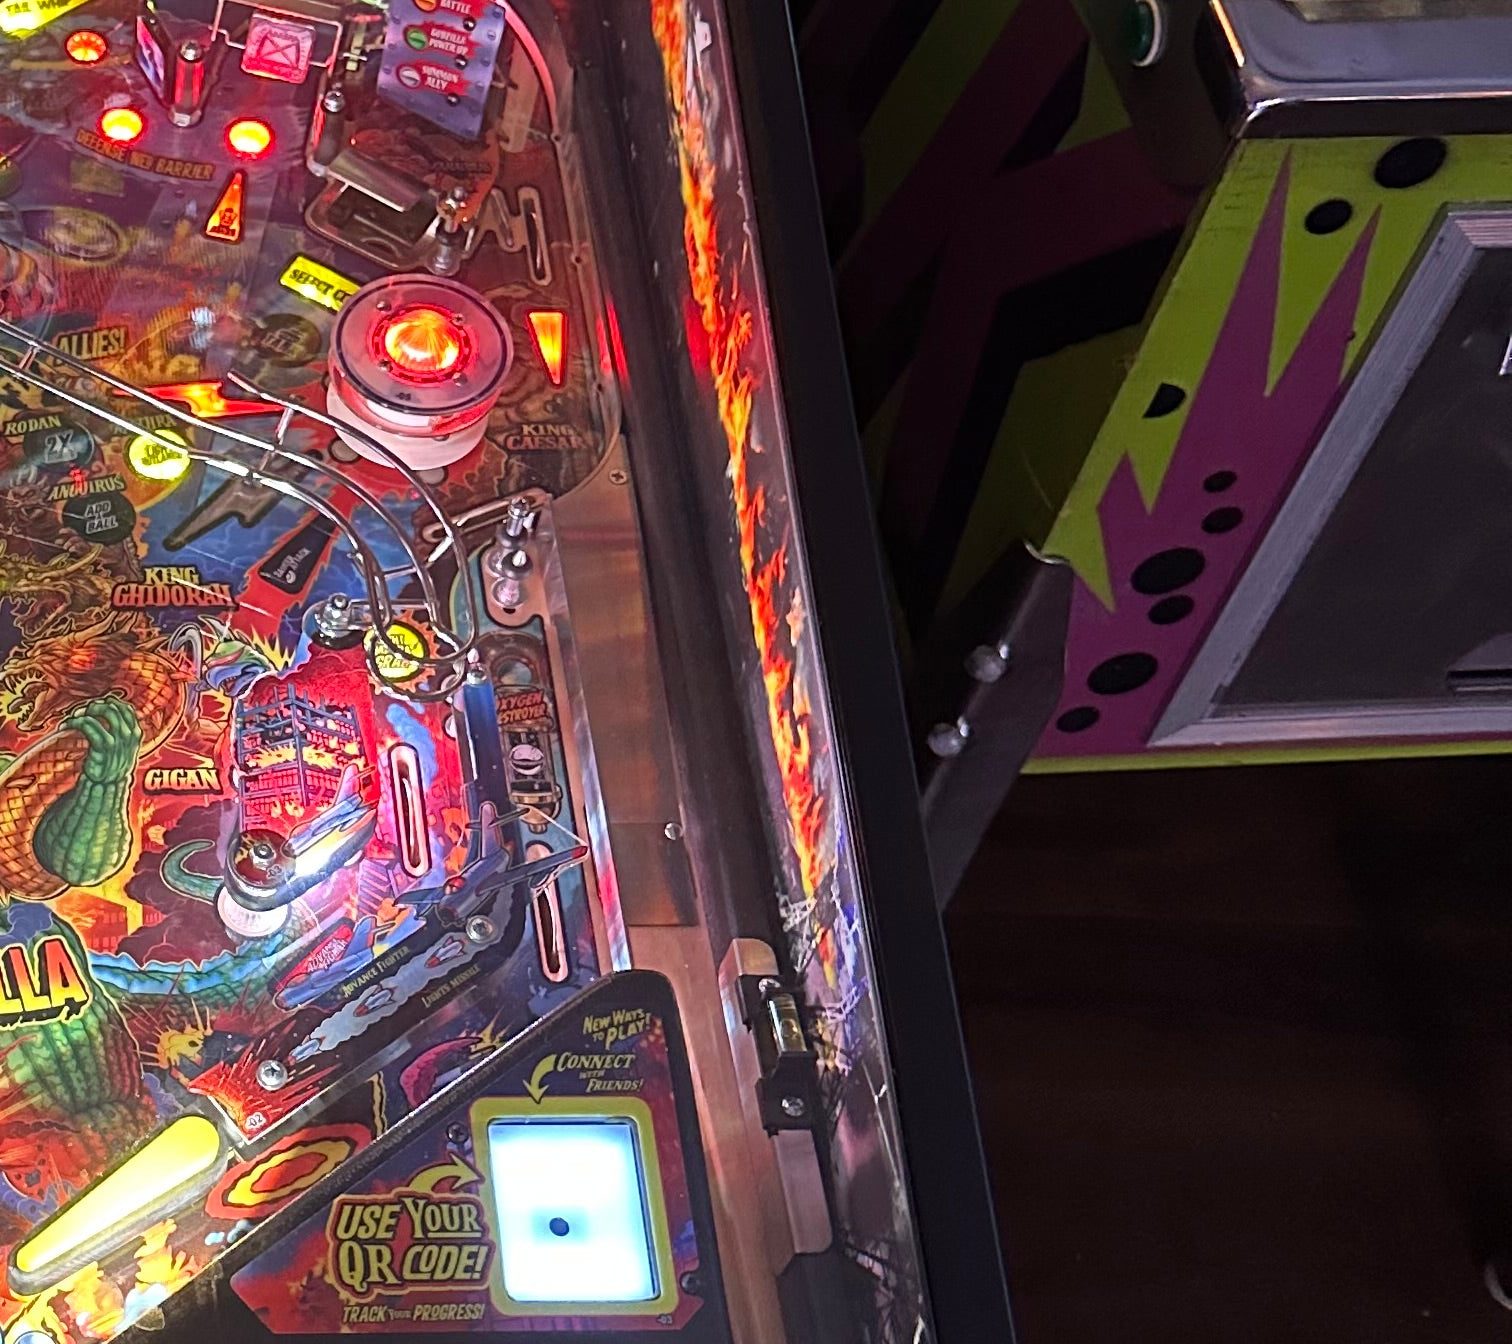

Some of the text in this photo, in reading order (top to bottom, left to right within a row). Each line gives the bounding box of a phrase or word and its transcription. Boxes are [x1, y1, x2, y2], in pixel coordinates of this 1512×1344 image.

[426, 77, 450, 90] ALLY
[5, 417, 61, 435] RODAN
[521, 424, 573, 436] KING
[44, 431, 76, 460] 2X
[85, 502, 110, 517] ADD
[86, 516, 117, 534] BALL
[144, 567, 199, 586] KING
[113, 583, 235, 607] GHIDORAH
[145, 767, 218, 791] GIGAN
[605, 1013, 651, 1051] PLAY!
[555, 1053, 636, 1069] CONNECT
[586, 1078, 644, 1093] FRIENDS!
[335, 1197, 482, 1241] USE YOUR
[339, 1241, 487, 1292] QR CODE!
[343, 1305, 388, 1323] TRACK
[413, 1303, 484, 1322] PROGRESS!
